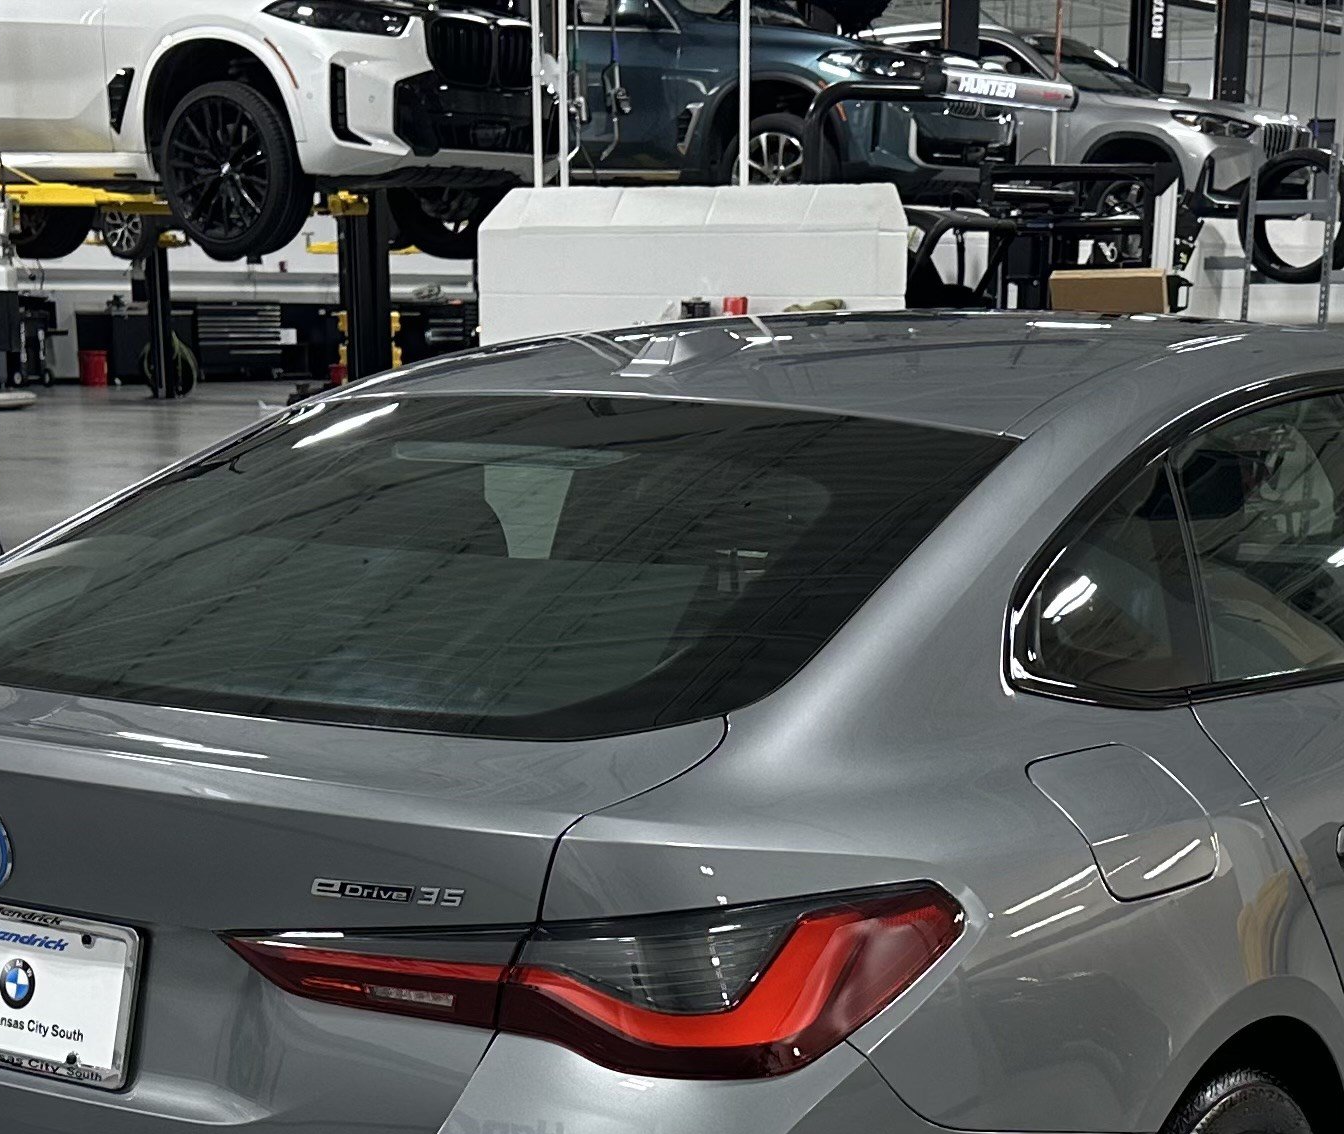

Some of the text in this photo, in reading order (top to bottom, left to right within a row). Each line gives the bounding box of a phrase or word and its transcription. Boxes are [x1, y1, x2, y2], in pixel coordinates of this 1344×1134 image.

[958, 76, 1017, 98] HUNTER
[416, 886, 465, 907] 35
[27, 1019, 50, 1038] City
[51, 1024, 84, 1042] South
[28, 1058, 60, 1074] City
[66, 1066, 103, 1082] South
